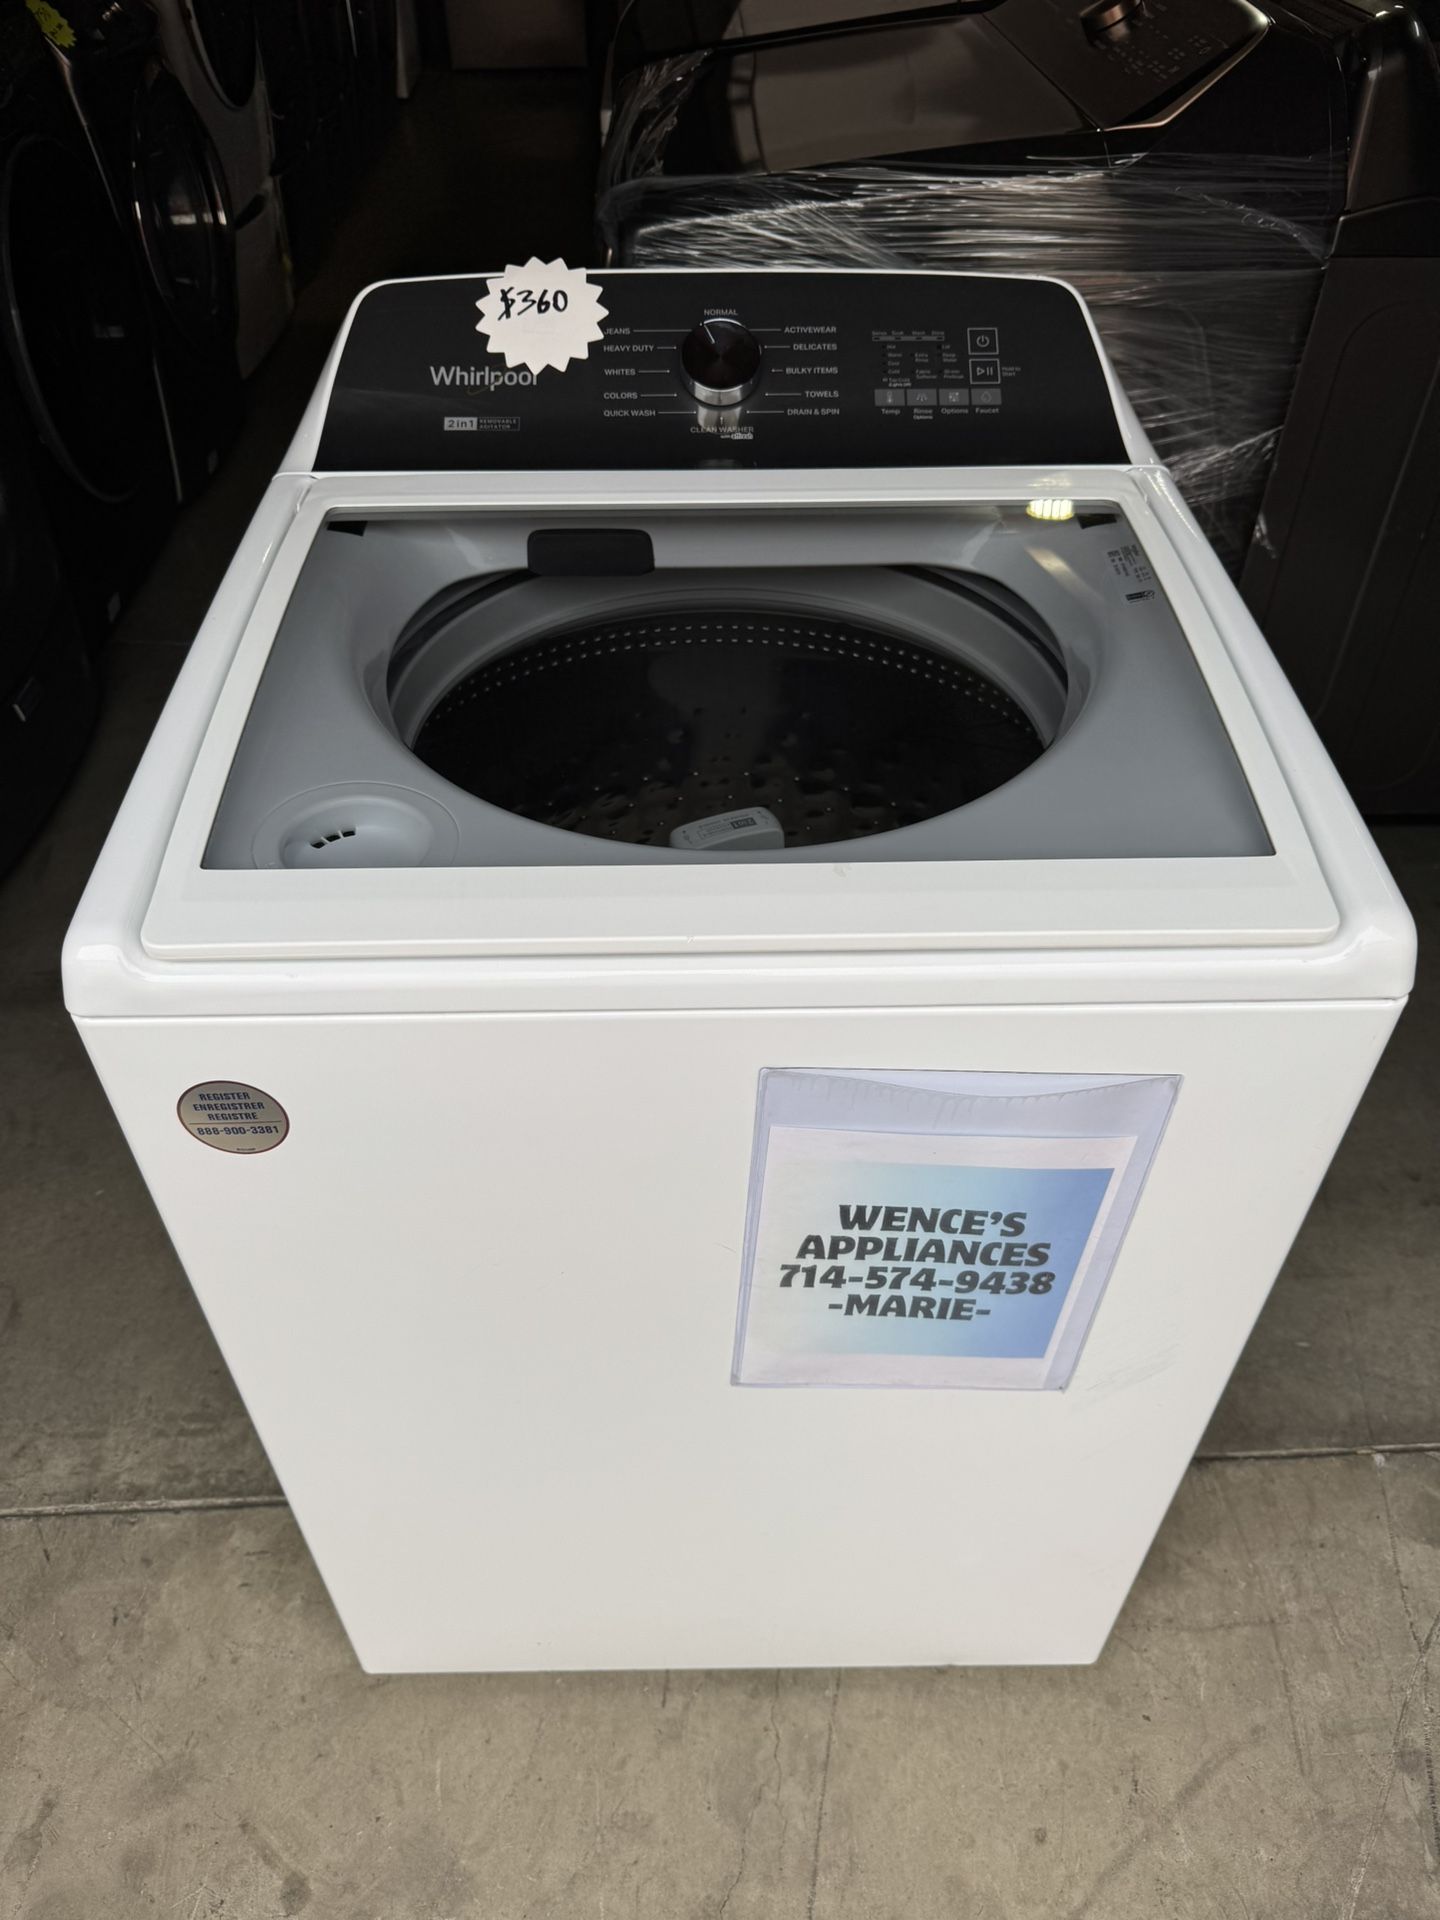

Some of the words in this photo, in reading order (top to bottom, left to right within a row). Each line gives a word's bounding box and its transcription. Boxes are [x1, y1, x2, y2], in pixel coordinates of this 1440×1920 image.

[498, 287, 568, 321] $360
[703, 308, 739, 317] NORMAL
[604, 327, 631, 336] JEANS
[783, 325, 837, 334] ACTIVEWEAR
[603, 345, 631, 353] HEAVY
[631, 344, 655, 353] DUTY
[792, 342, 838, 351] DELICATES
[603, 367, 637, 376] WHITES
[785, 366, 813, 376] BULKY
[813, 366, 839, 375] ITEMS
[430, 366, 537, 391] Whirlpool
[603, 391, 639, 400] COLORS
[804, 390, 840, 399] TOWELS
[603, 409, 630, 418] QUICK
[630, 409, 656, 417] WASH
[787, 408, 812, 416] DRAIN
[813, 408, 820, 416] &
[821, 407, 840, 416] SPIN
[881, 407, 900, 416] Temp
[941, 406, 969, 415] Options
[975, 406, 999, 414] Faucet
[690, 426, 718, 434] CLEAN
[718, 426, 754, 434] WASHER
[199, 1092, 250, 1101] REGISTER
[193, 1102, 264, 1111] ENREGISTRER
[207, 1112, 259, 1121] REGISTRE
[197, 1126, 279, 1135] 888-900-3381
[839, 1205, 1028, 1237] WENCE'S
[796, 1235, 1051, 1267] APPLIANCES
[780, 1265, 1056, 1296] 714-574-9438
[828, 1294, 991, 1321] -MARIE-
